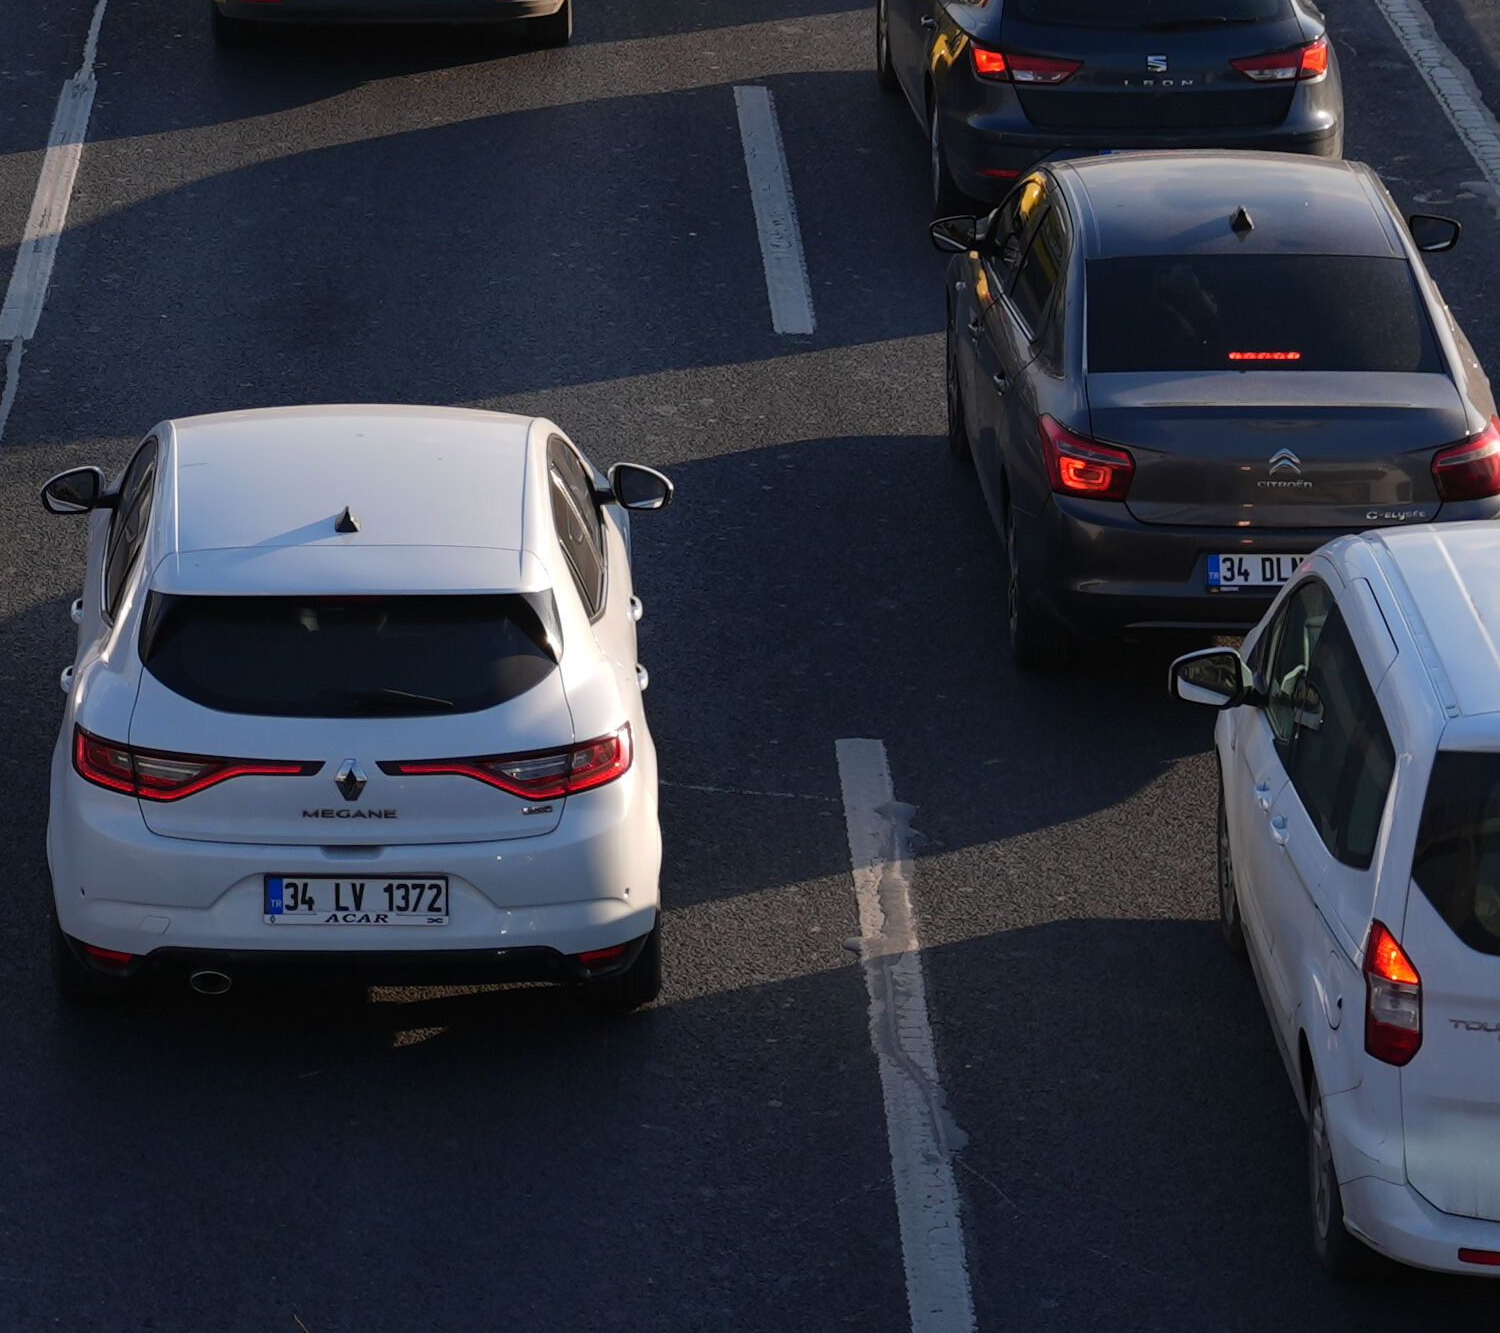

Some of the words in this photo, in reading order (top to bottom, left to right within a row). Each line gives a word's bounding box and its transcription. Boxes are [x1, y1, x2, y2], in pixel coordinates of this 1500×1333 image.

[1123, 78, 1194, 87] LEON
[1256, 478, 1314, 488] CITROËN
[1222, 557, 1249, 583] 34
[301, 807, 398, 819] MEGANE
[270, 899, 283, 909] TR
[284, 884, 315, 912] 34
[334, 884, 365, 912] LV
[383, 883, 443, 914] 1372
[324, 914, 389, 924] ACAR
